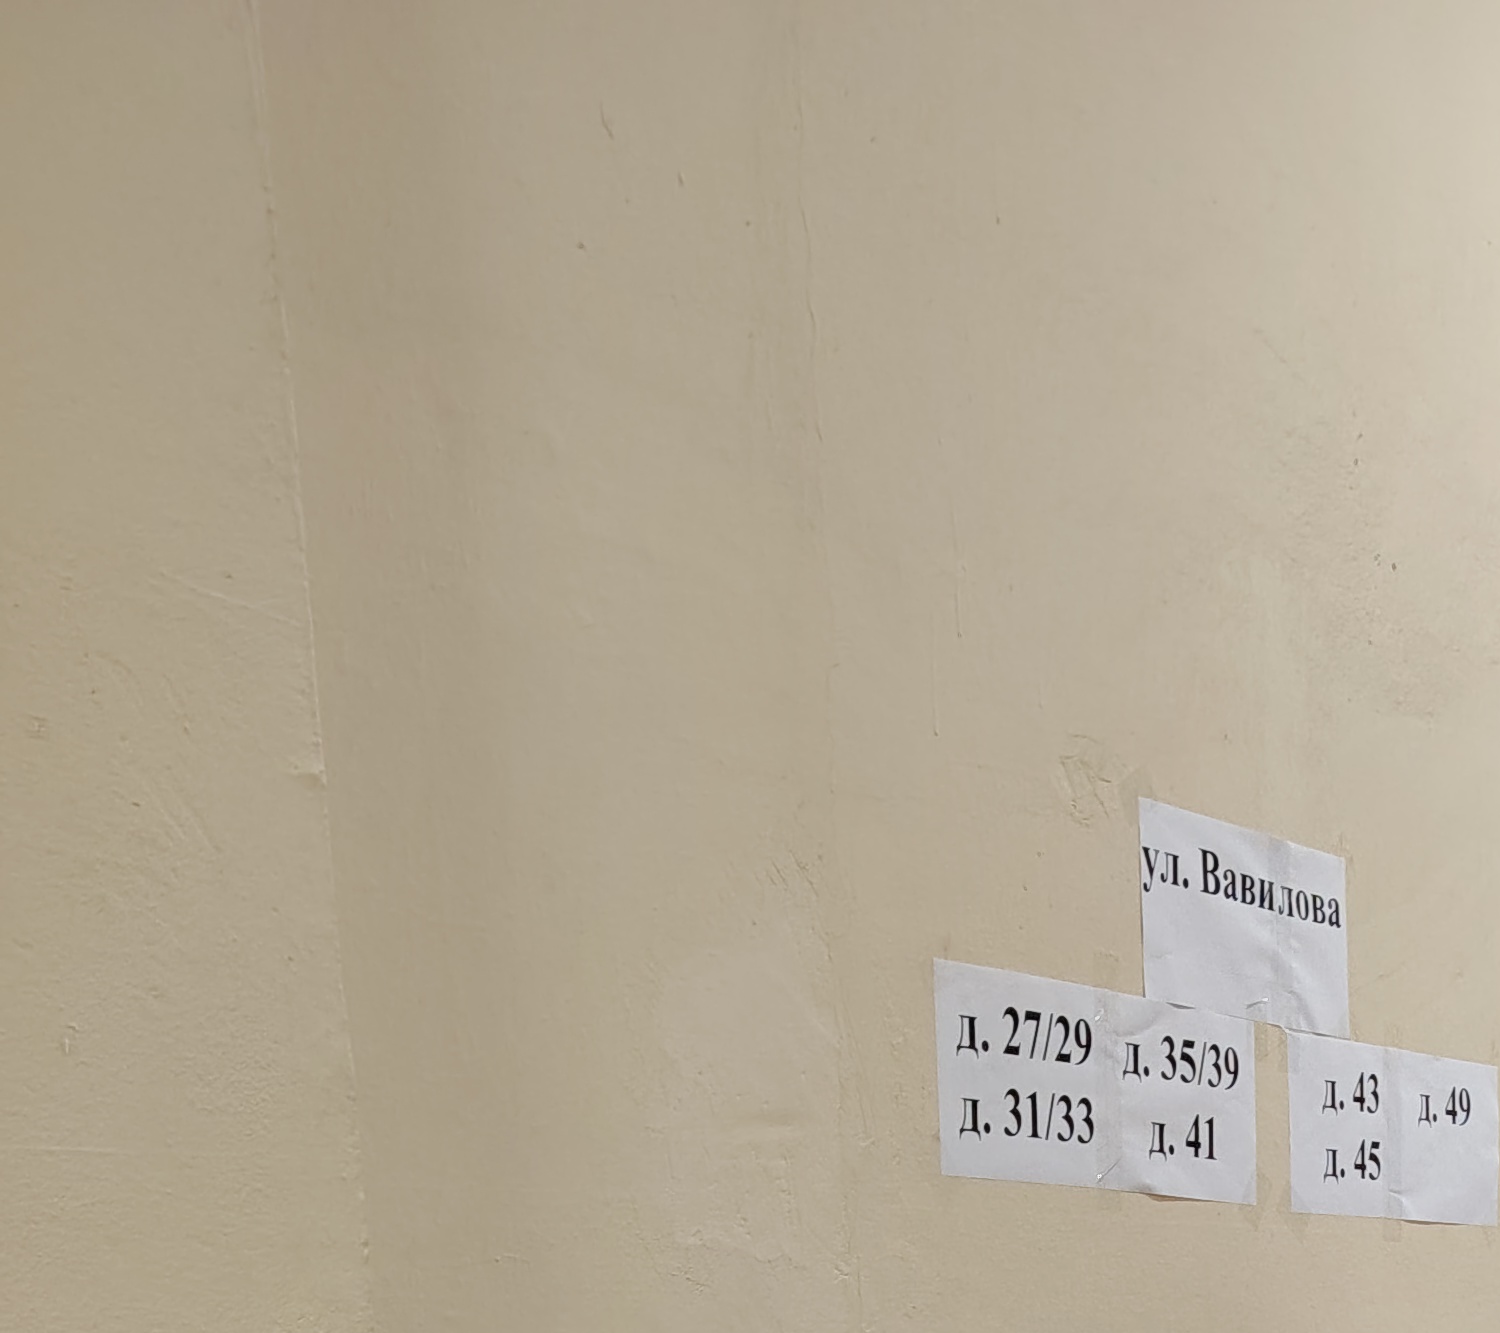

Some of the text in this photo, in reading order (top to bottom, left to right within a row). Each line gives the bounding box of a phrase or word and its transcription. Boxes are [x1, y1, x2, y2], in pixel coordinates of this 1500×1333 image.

[1141, 846, 1341, 929] ул. Вавилова
[956, 1006, 1092, 1066] д. 27/29
[1122, 1035, 1239, 1090] д. 35/39
[959, 1088, 1095, 1144] д. 31/33
[1322, 1072, 1379, 1114] д. 43
[1418, 1087, 1471, 1125] д. 49
[1149, 1114, 1216, 1160] д. 41
[1323, 1139, 1381, 1181] д. 45
